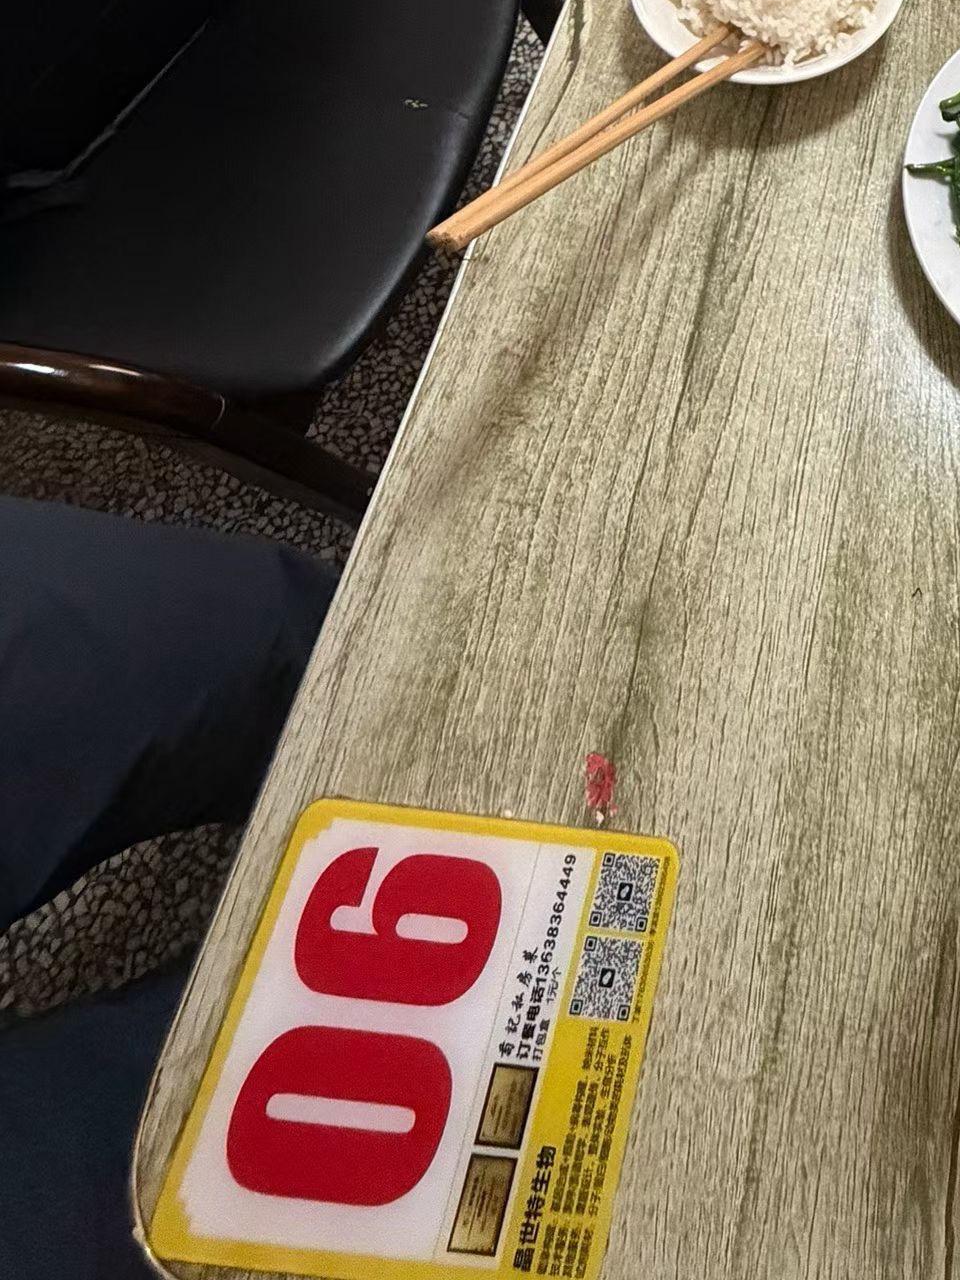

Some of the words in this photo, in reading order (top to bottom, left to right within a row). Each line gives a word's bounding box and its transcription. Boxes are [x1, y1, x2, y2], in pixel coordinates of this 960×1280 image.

[226, 846, 502, 1207] 06
[531, 1017, 551, 1062] 打包盒
